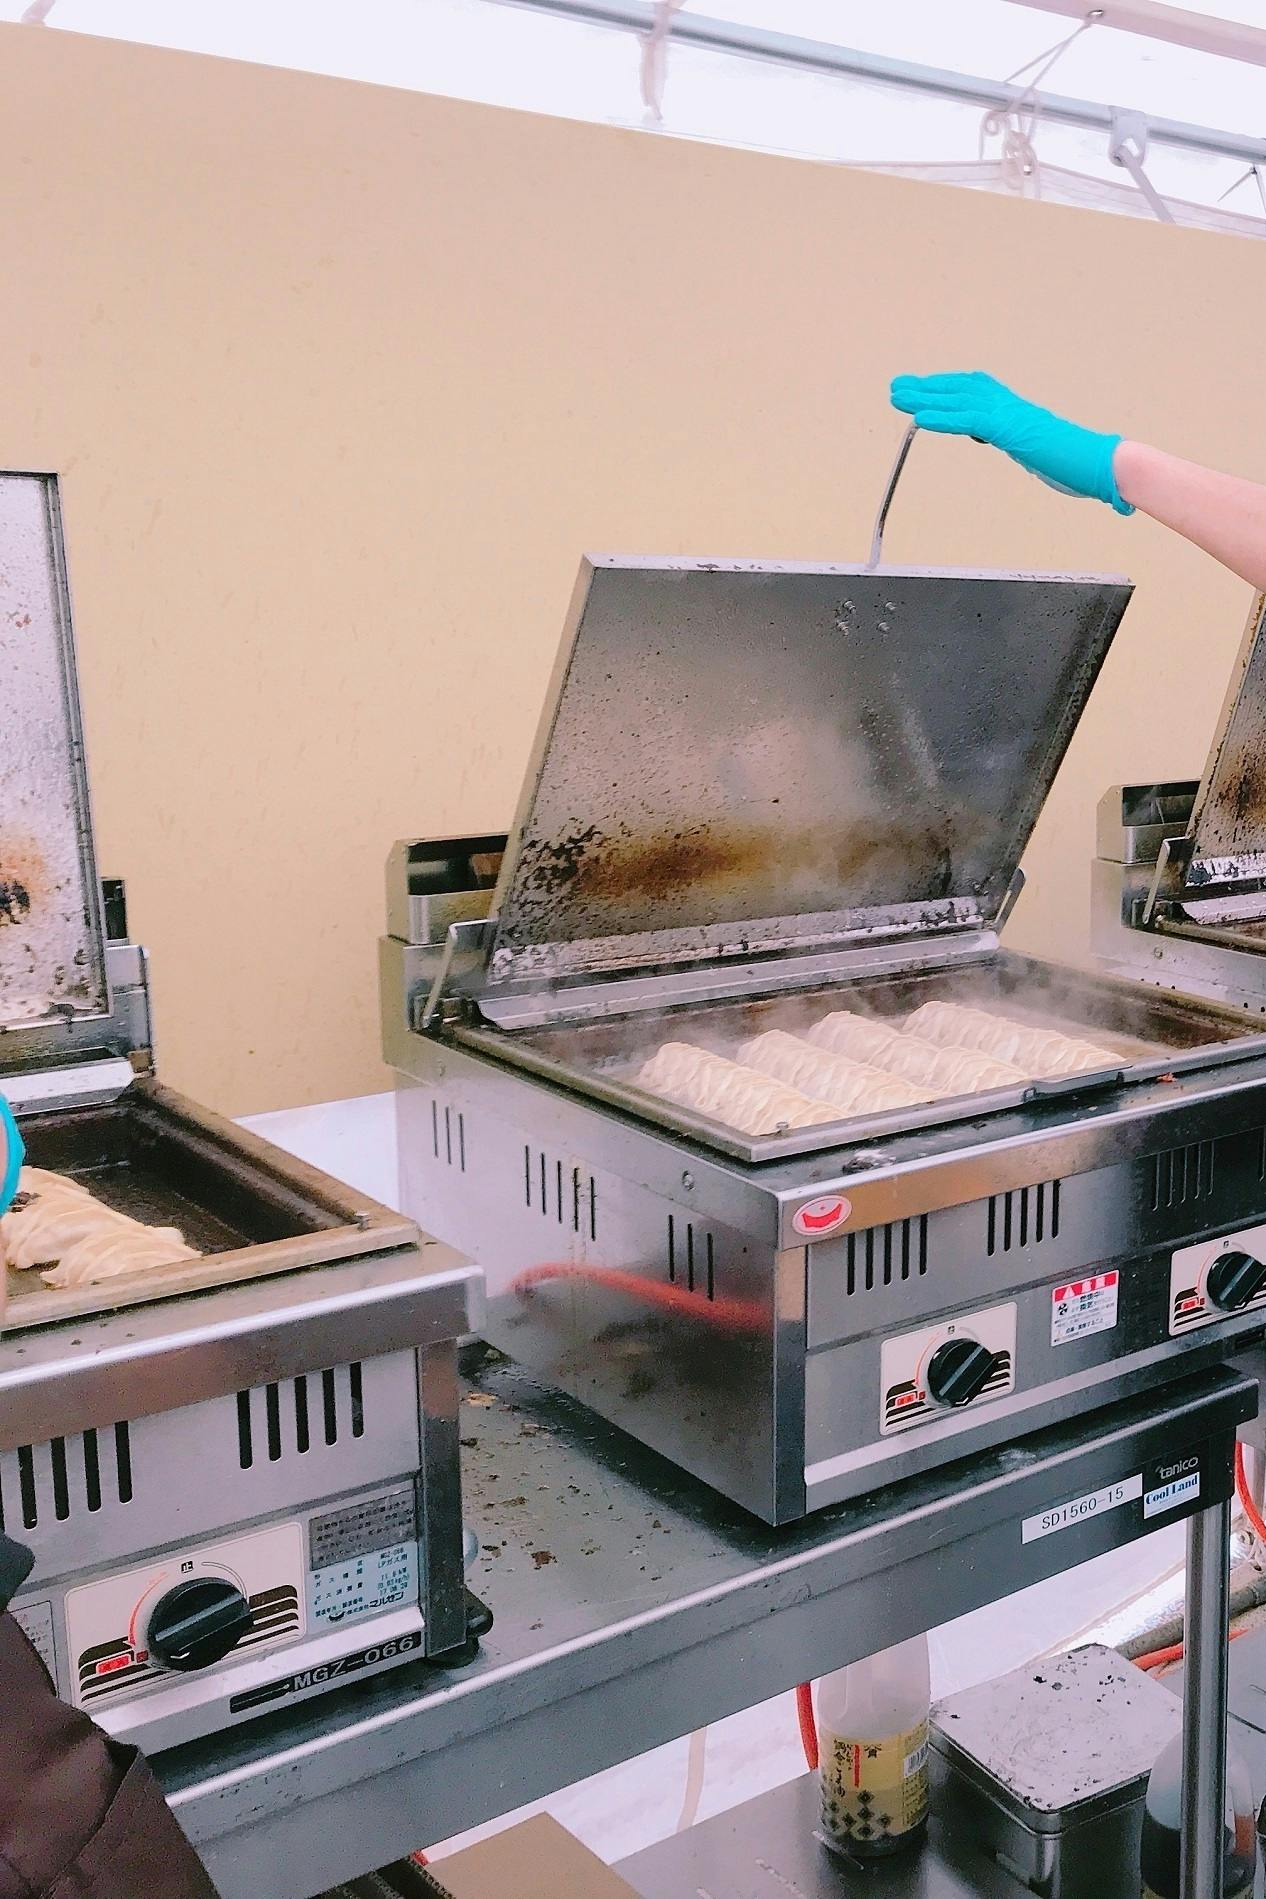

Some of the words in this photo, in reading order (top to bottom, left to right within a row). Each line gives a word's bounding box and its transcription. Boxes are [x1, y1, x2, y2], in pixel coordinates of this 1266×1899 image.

[1156, 1456, 1199, 1480] tanico
[1041, 1486, 1124, 1530] SD1560-15
[1145, 1488, 1169, 1505] Cool
[1171, 1475, 1198, 1495] Land
[291, 1637, 415, 1691] MGZ-066
